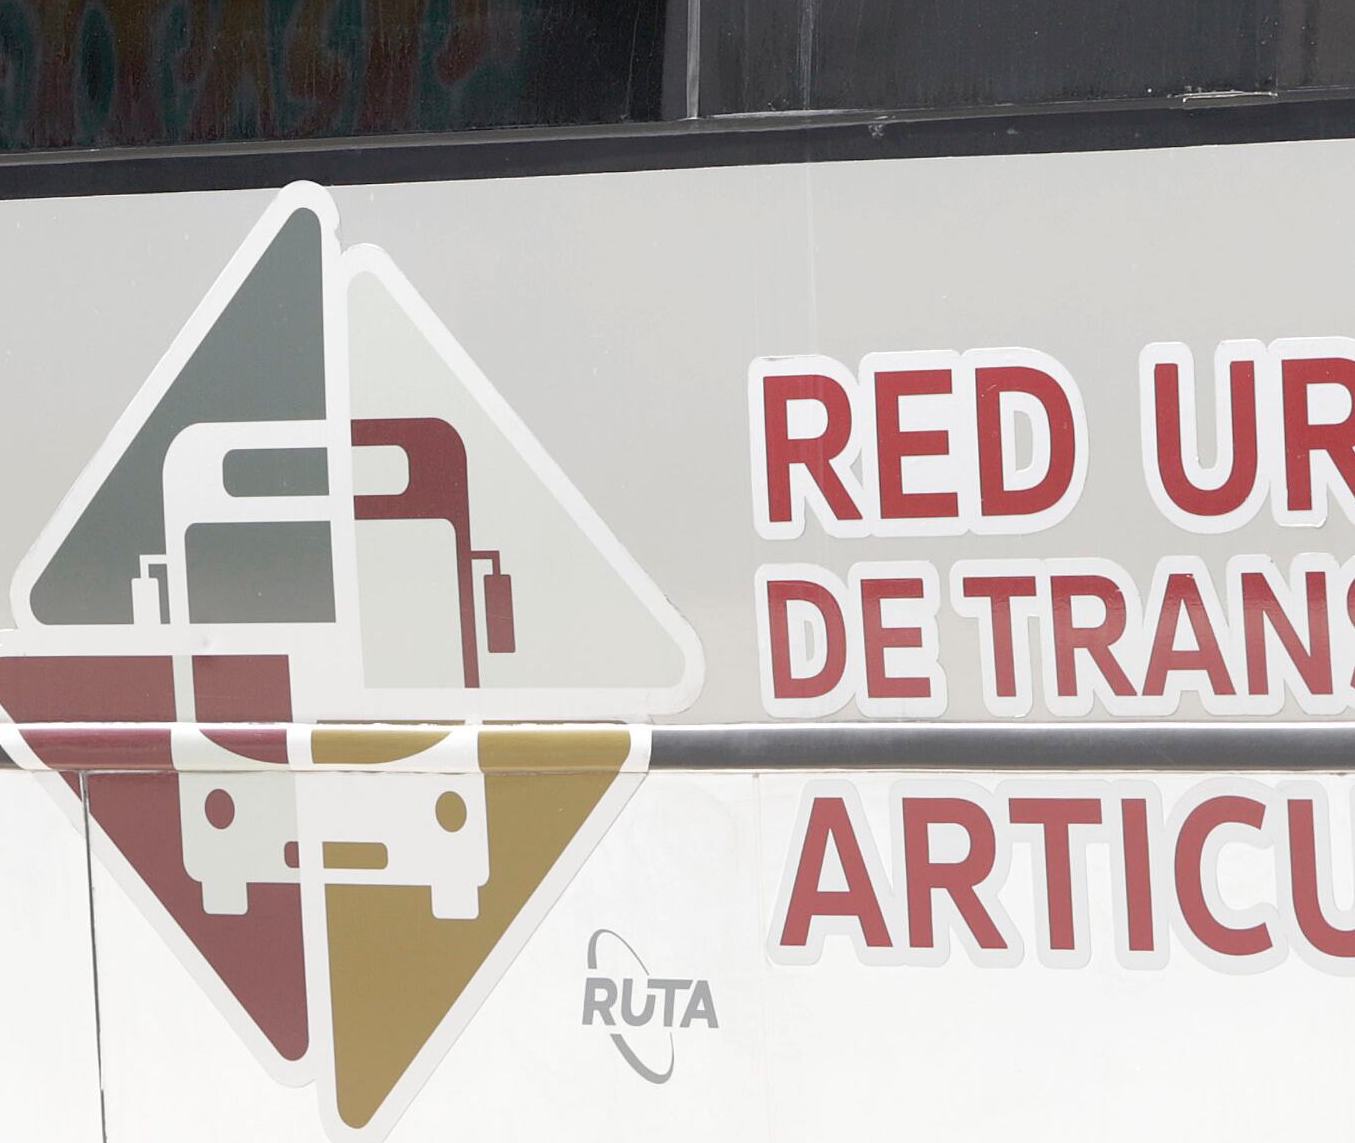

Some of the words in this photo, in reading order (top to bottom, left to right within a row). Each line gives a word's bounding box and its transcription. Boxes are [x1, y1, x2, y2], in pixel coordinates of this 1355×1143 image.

[764, 367, 1076, 523] RED
[768, 579, 931, 699] DE
[581, 977, 719, 1028] RUTA
